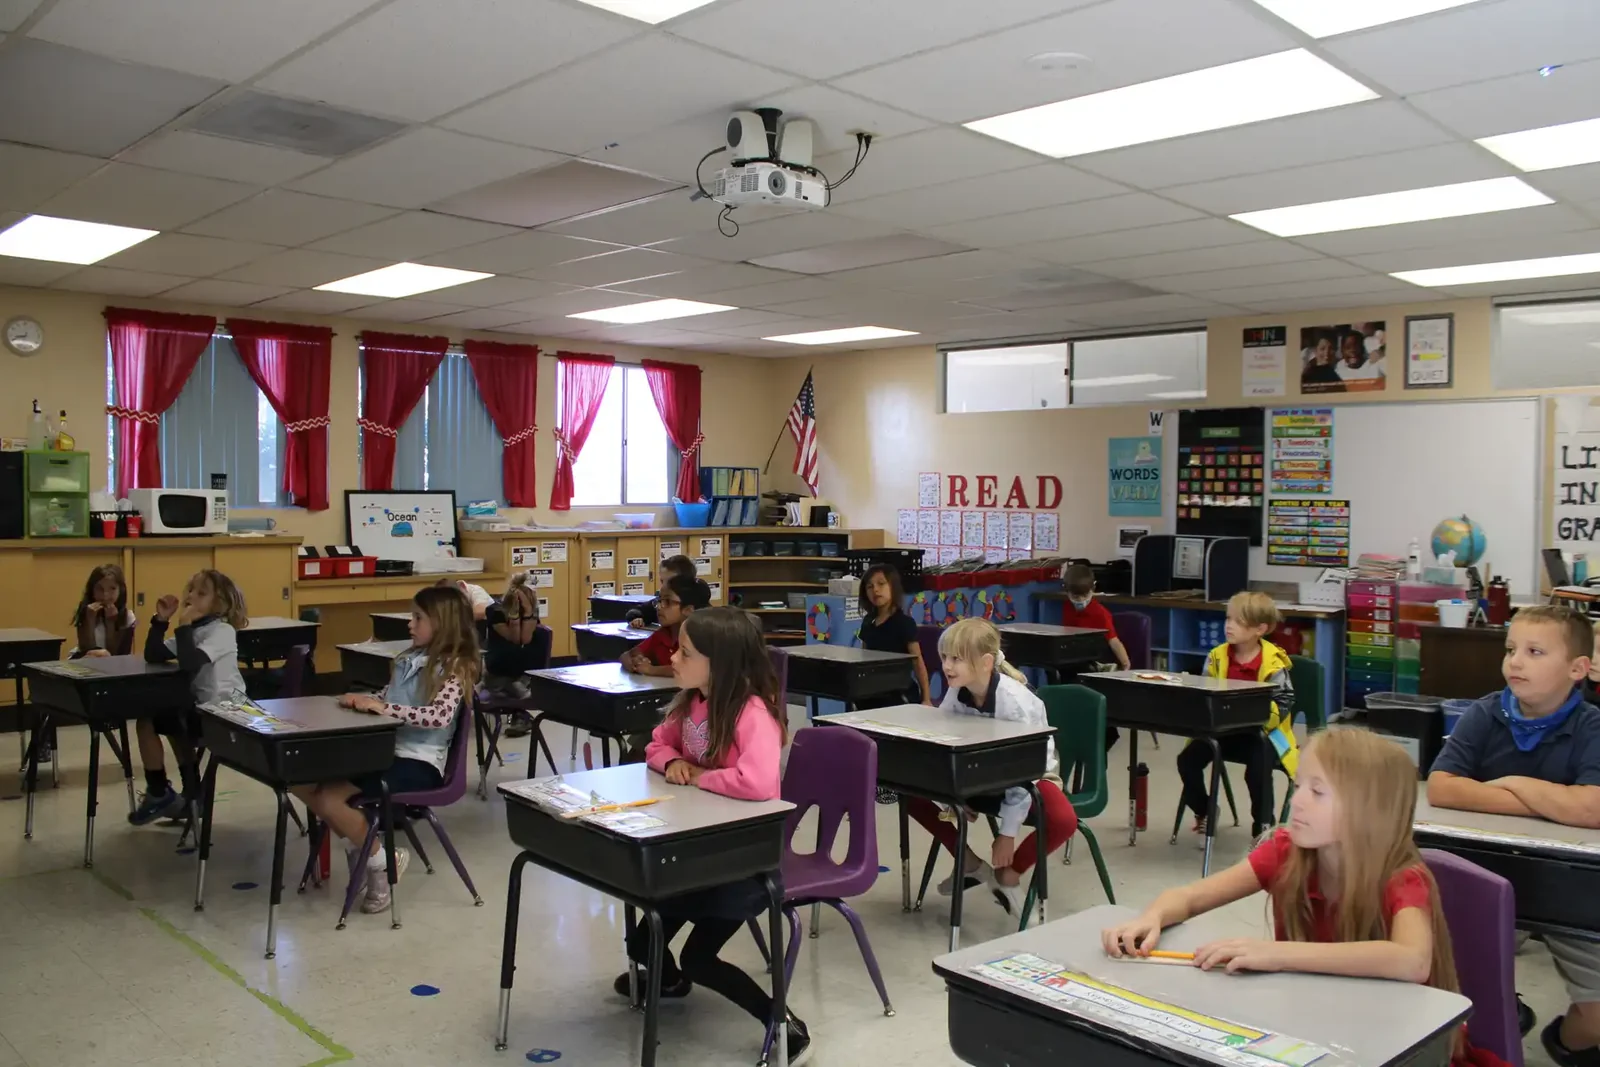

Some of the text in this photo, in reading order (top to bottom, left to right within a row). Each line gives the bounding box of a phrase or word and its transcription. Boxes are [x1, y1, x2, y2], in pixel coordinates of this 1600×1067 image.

[1150, 411, 1163, 427] W
[1288, 439, 1316, 447] Tuesday
[1282, 450, 1321, 458] Wednesday
[1110, 468, 1159, 481] WORDS
[947, 475, 1063, 509] READ
[1560, 482, 1598, 505] IN
[387, 512, 417, 521] Ocean
